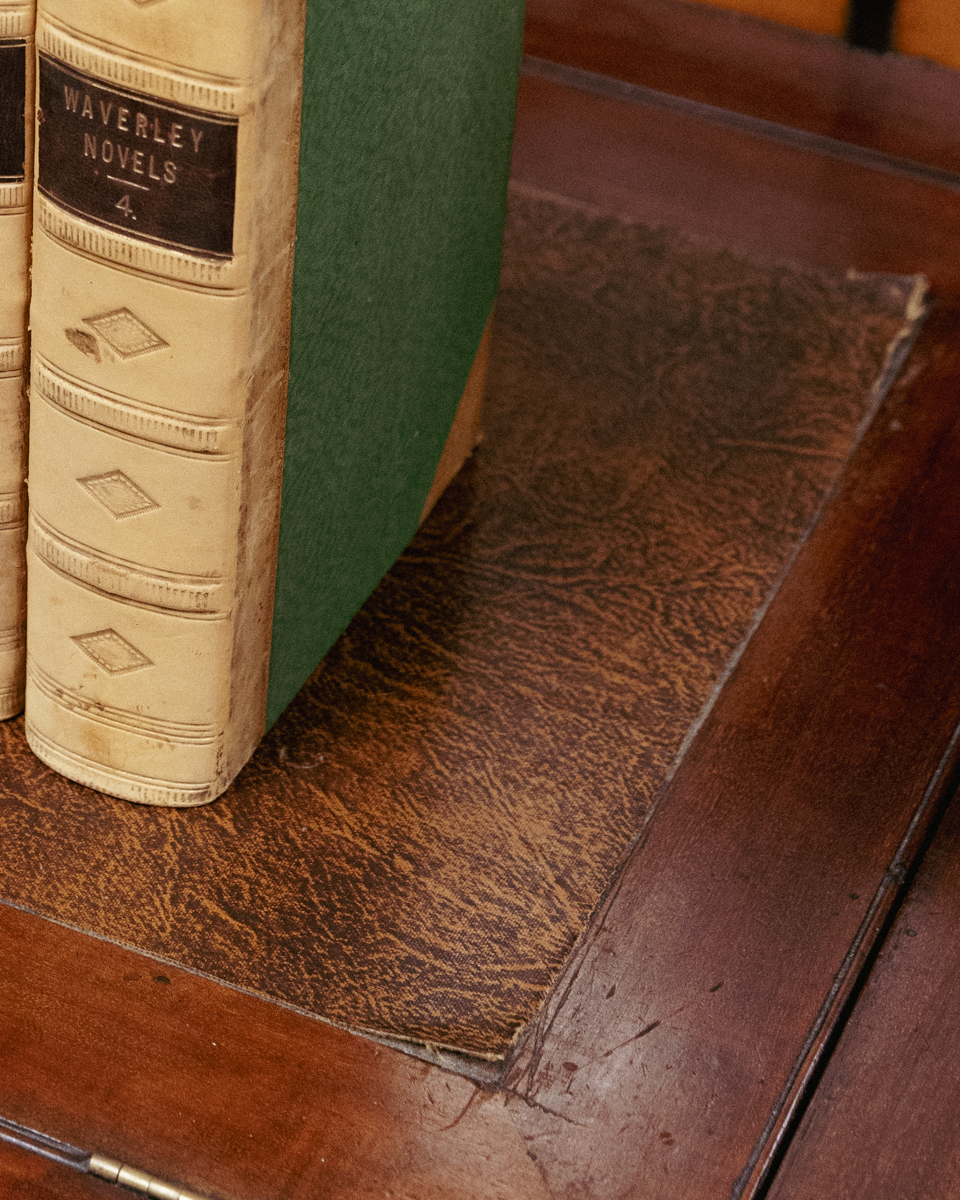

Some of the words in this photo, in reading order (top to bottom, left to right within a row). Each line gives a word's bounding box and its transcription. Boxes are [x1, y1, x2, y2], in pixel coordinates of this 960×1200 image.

[63, 85, 203, 153] WAVERLEY
[83, 132, 178, 184] NOVELS
[114, 194, 137, 220] 4.
